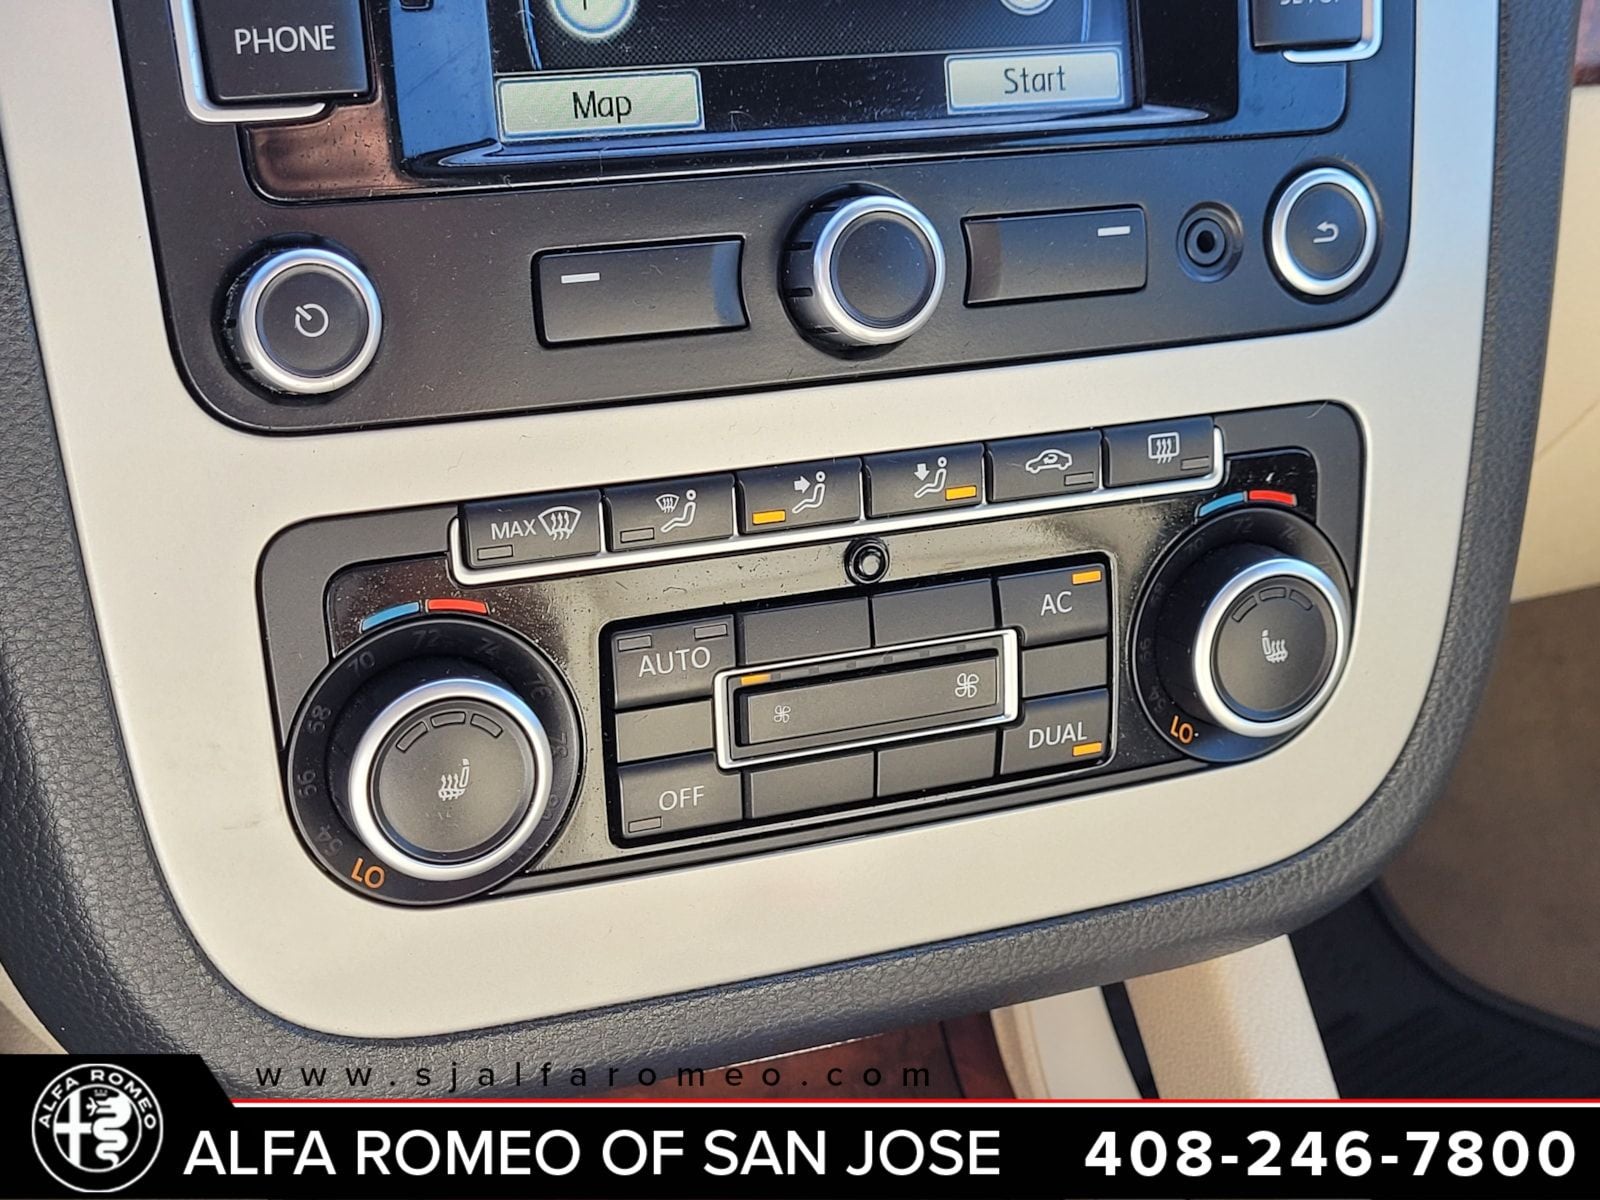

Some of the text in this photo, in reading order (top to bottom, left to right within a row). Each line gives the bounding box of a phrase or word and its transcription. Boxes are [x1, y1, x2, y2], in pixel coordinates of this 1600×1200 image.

[234, 24, 336, 54] PHONE
[1003, 65, 1067, 95] Start
[571, 91, 632, 122] Map
[490, 519, 537, 540] MAX
[1040, 590, 1073, 616] AC
[411, 630, 440, 649] 72
[347, 651, 376, 677] 70
[638, 646, 711, 677] AUTO
[1028, 721, 1088, 748] DUAL
[1170, 715, 1194, 744] LO
[658, 785, 704, 810] OFF
[350, 857, 386, 889] LO
